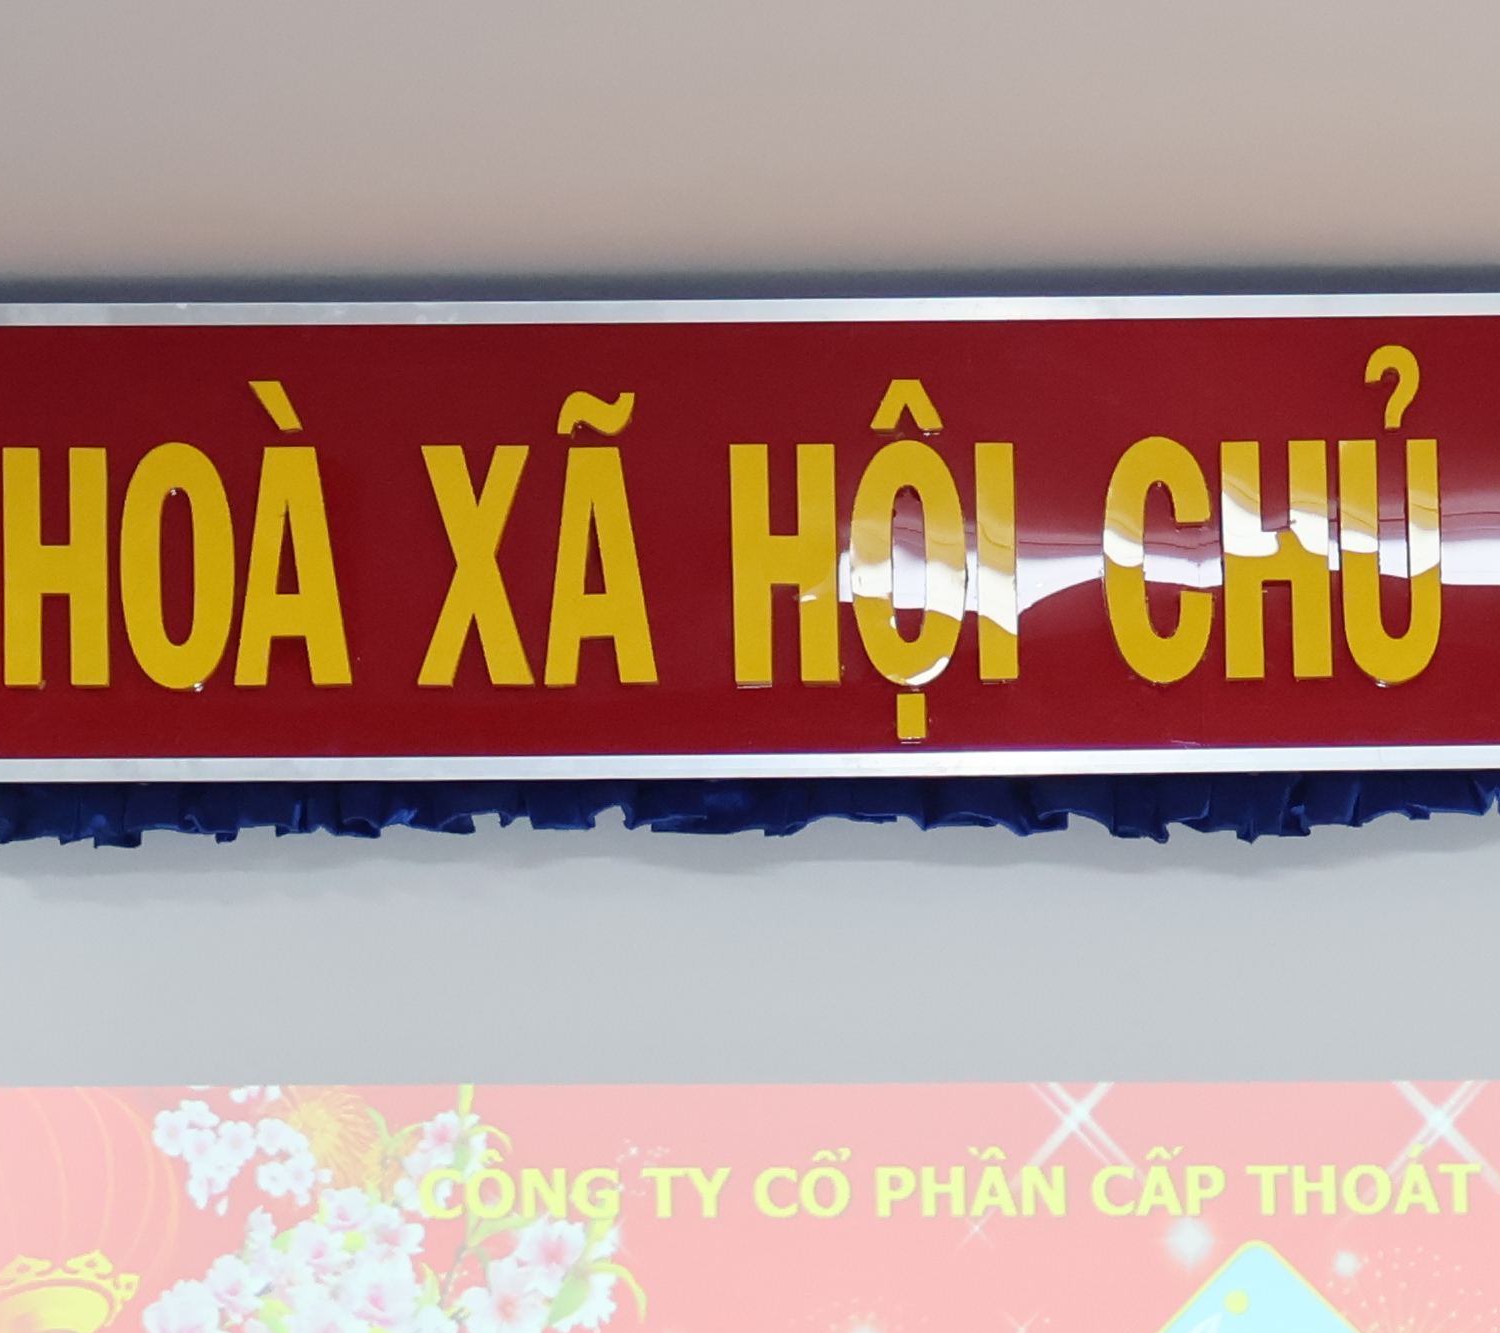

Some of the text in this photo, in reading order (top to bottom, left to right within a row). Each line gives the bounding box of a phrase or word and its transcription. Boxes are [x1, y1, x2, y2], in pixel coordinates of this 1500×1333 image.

[3, 381, 352, 690] HOÀ
[418, 392, 658, 688] XÃ
[730, 379, 1019, 740] HỘI
[1106, 345, 1442, 685] CHỦ
[418, 1148, 621, 1219] CÔNG
[643, 1165, 731, 1217] TY
[753, 1147, 851, 1218] CỔ
[875, 1145, 1067, 1217] PHẦN
[1090, 1145, 1226, 1215] CẤP
[1246, 1144, 1481, 1215] THOÁT
